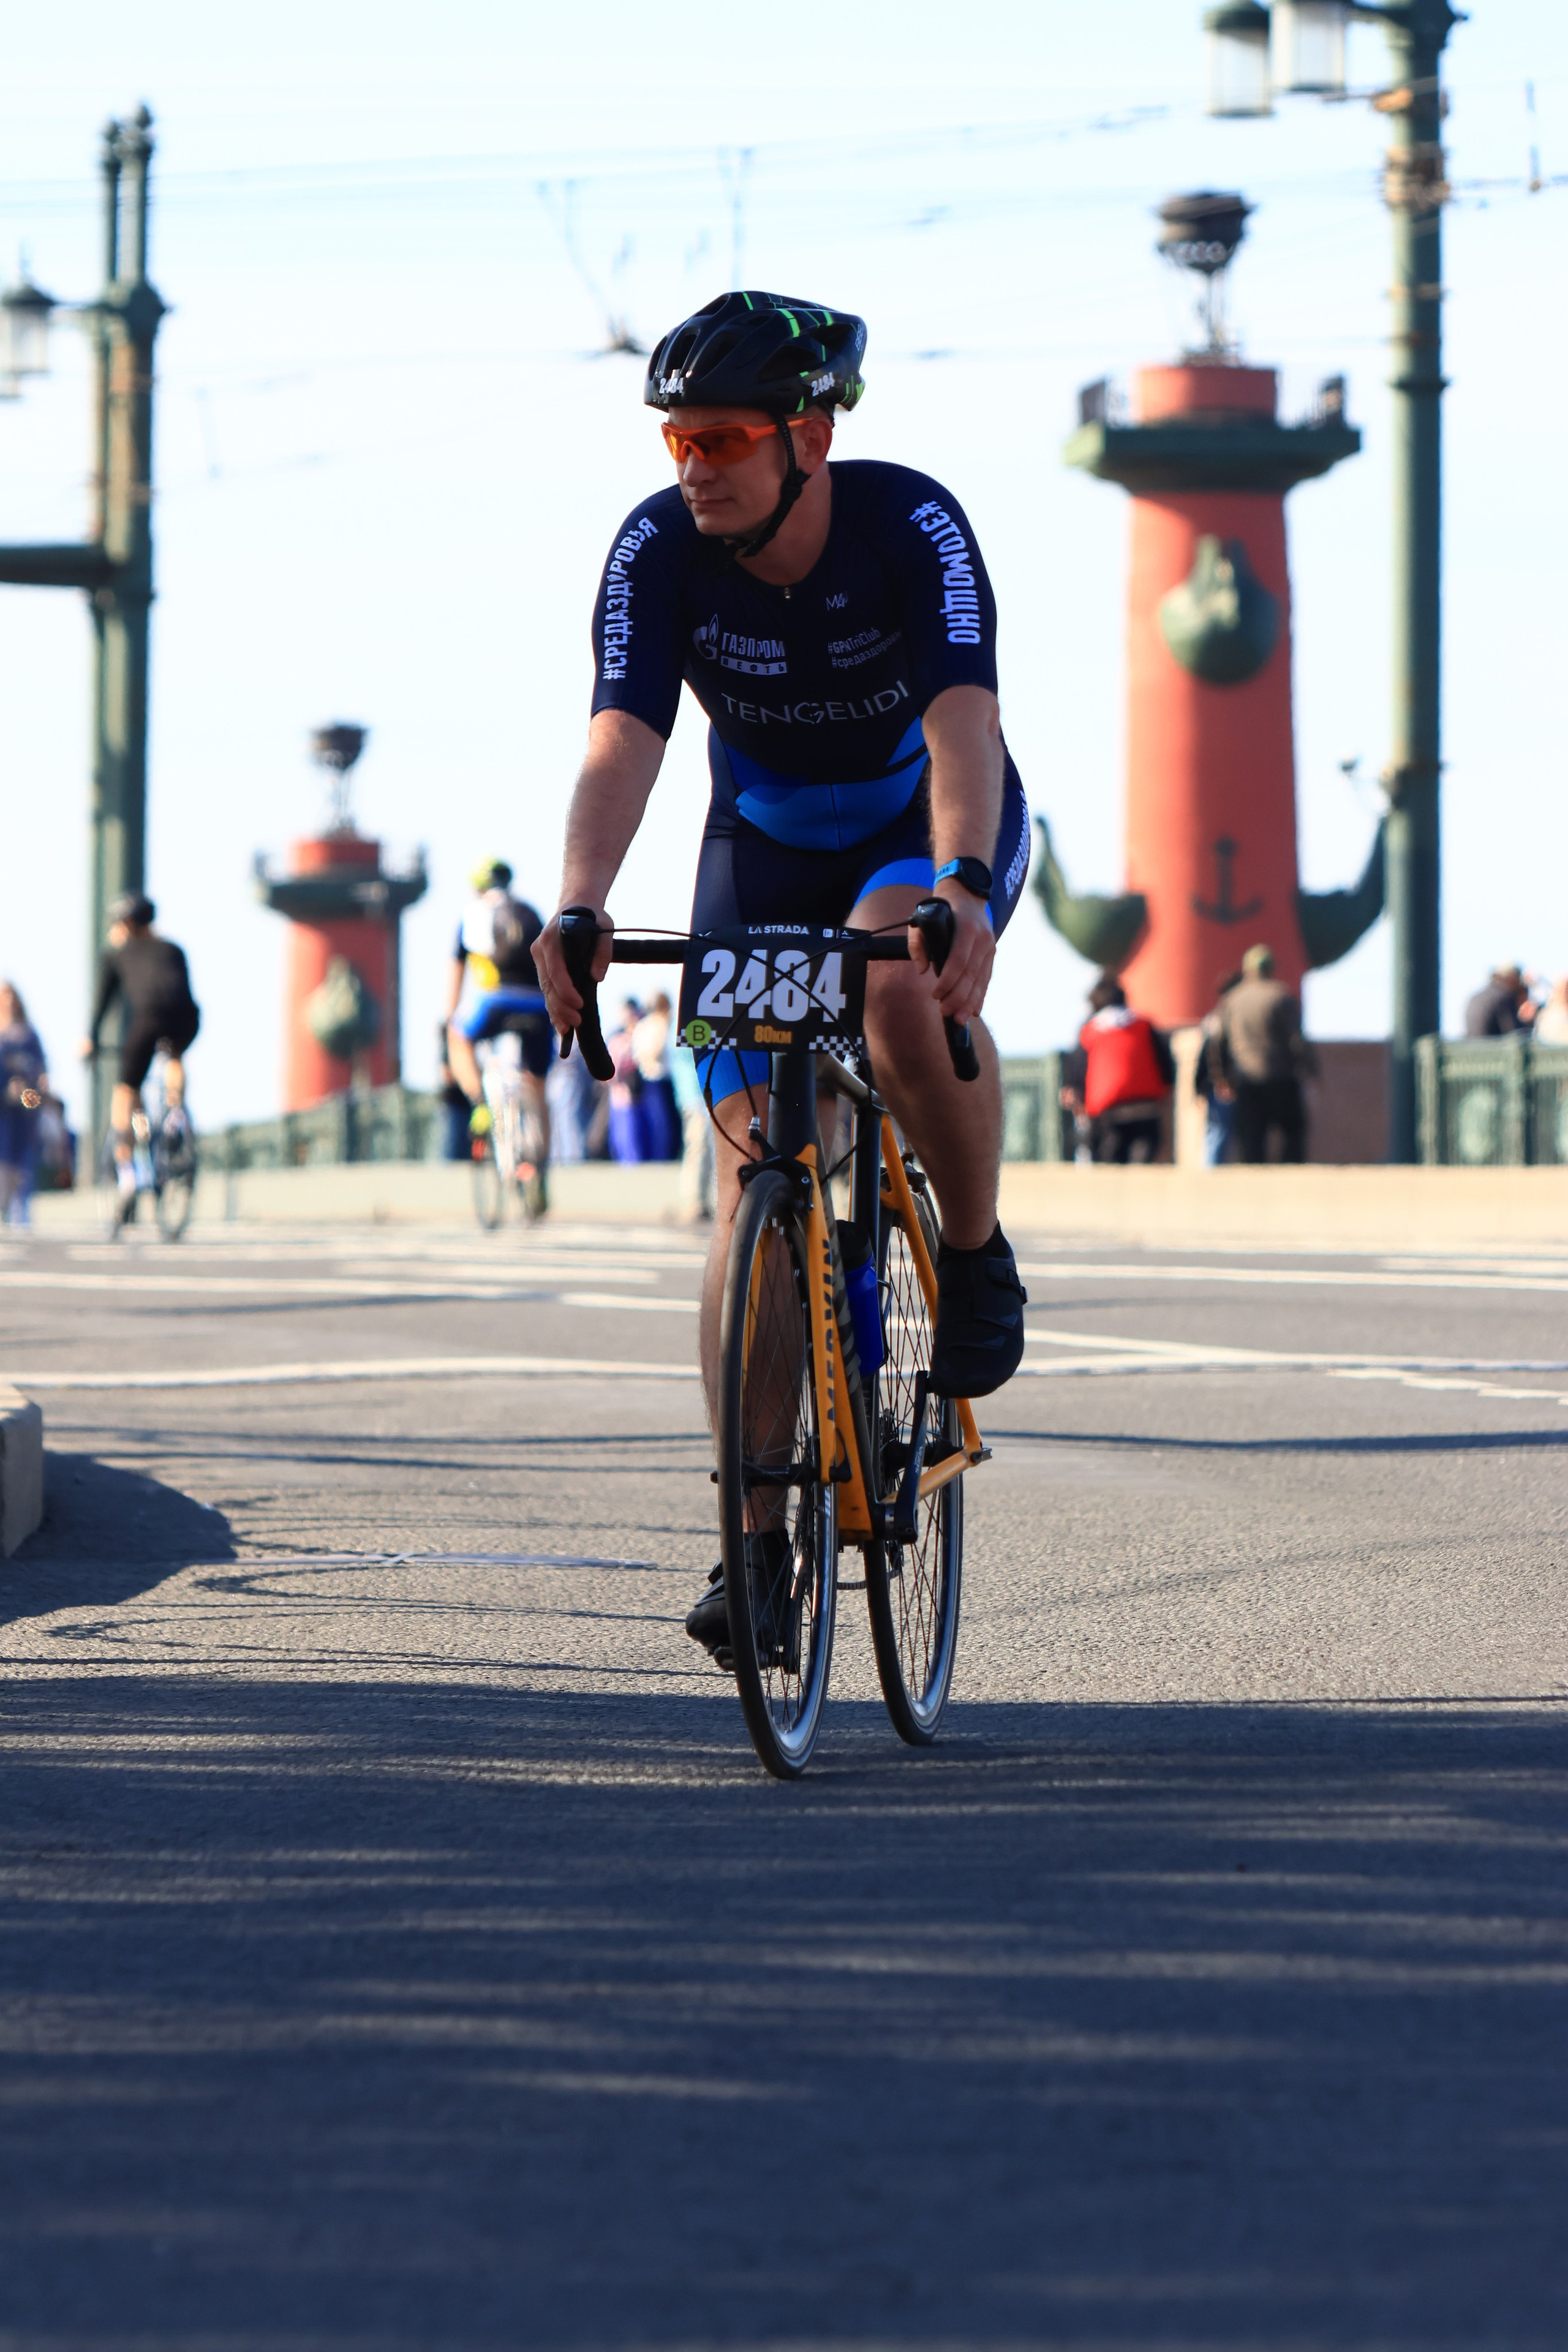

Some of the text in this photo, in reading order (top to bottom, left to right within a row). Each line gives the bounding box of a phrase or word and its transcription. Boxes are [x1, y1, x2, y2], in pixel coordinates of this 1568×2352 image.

[909, 500, 981, 644] #ЭТОМОЩНО
[721, 632, 785, 658] ГАЗПРОМ
[827, 627, 881, 654] #GPNTriClub
[723, 657, 785, 674] НЕФТЬ
[721, 680, 908, 725] TENGELIDI
[764, 925, 810, 935] STRADA
[697, 949, 847, 1023] 2484
[693, 1025, 706, 1041] B
